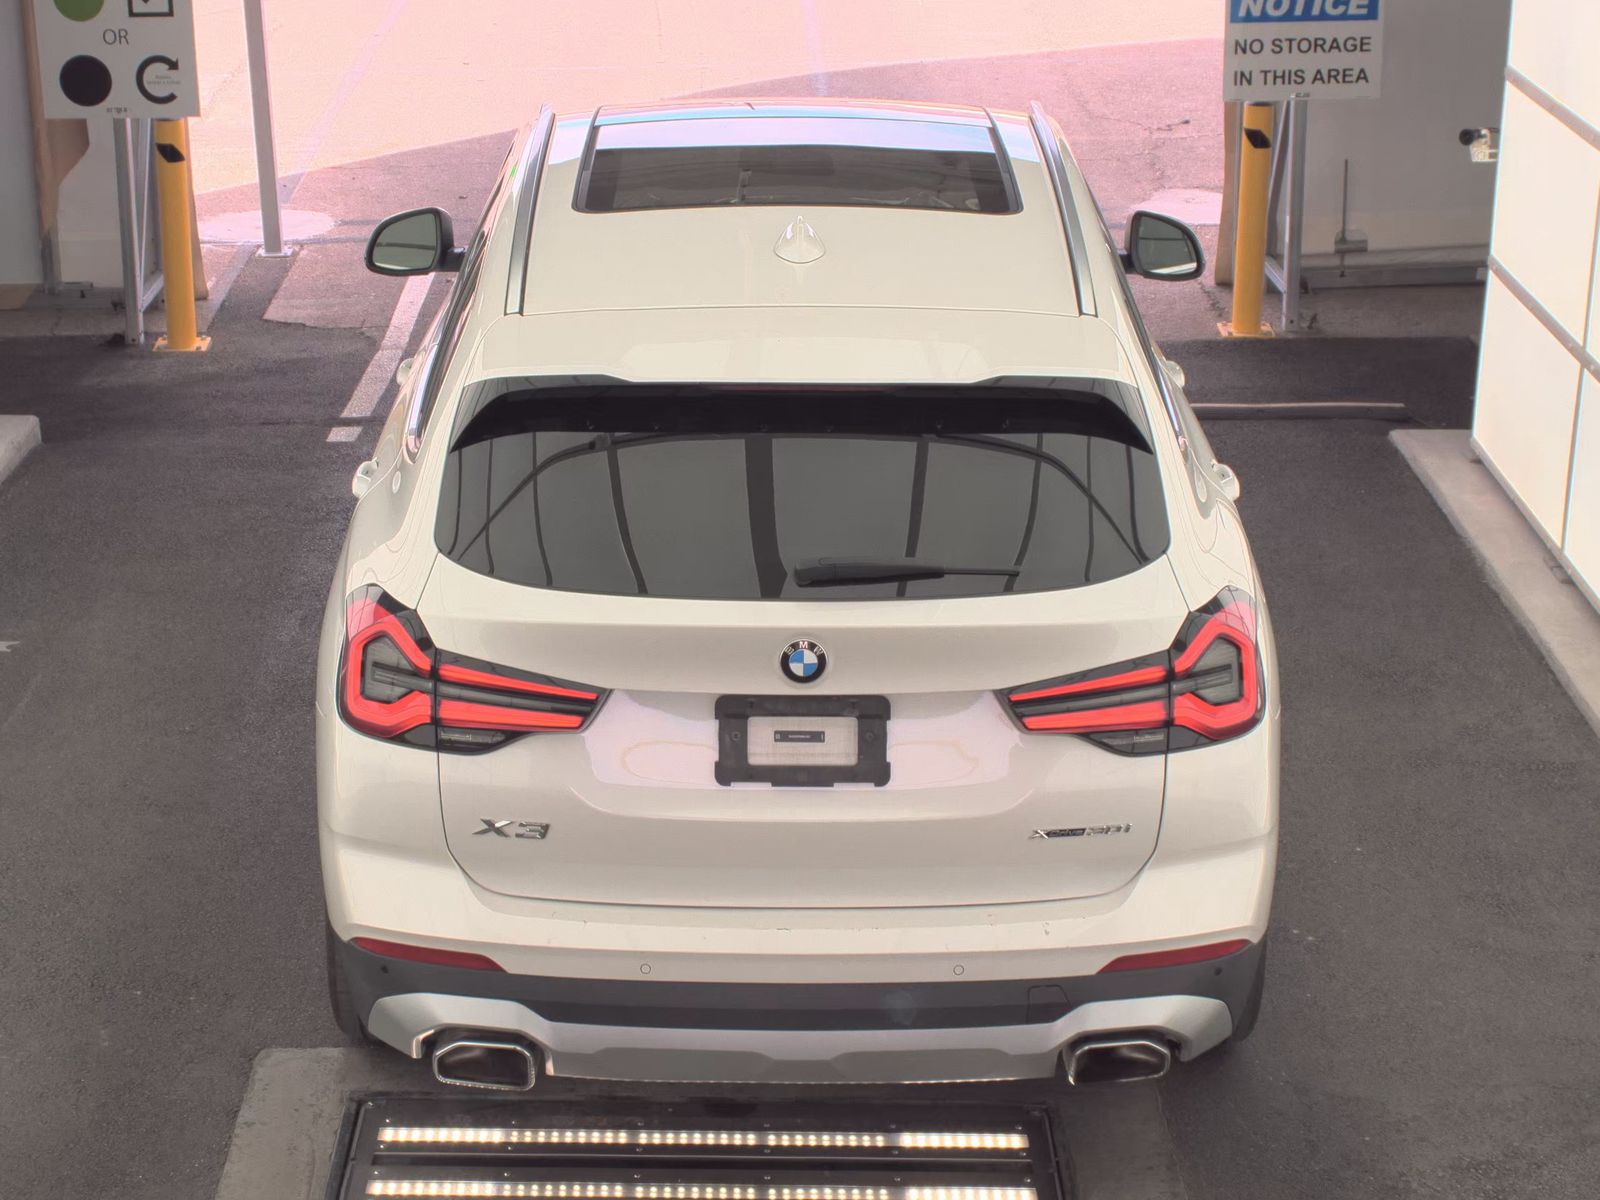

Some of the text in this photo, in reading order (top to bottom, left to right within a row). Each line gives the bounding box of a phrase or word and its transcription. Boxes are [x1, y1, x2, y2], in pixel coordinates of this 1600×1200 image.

[1237, 0, 1369, 16] NOTICE
[102, 28, 129, 45] OR
[1234, 36, 1372, 55] NO STORAGE
[1233, 68, 1369, 86] IN THIS AREA
[784, 640, 824, 656] BMW
[471, 818, 550, 840] X3
